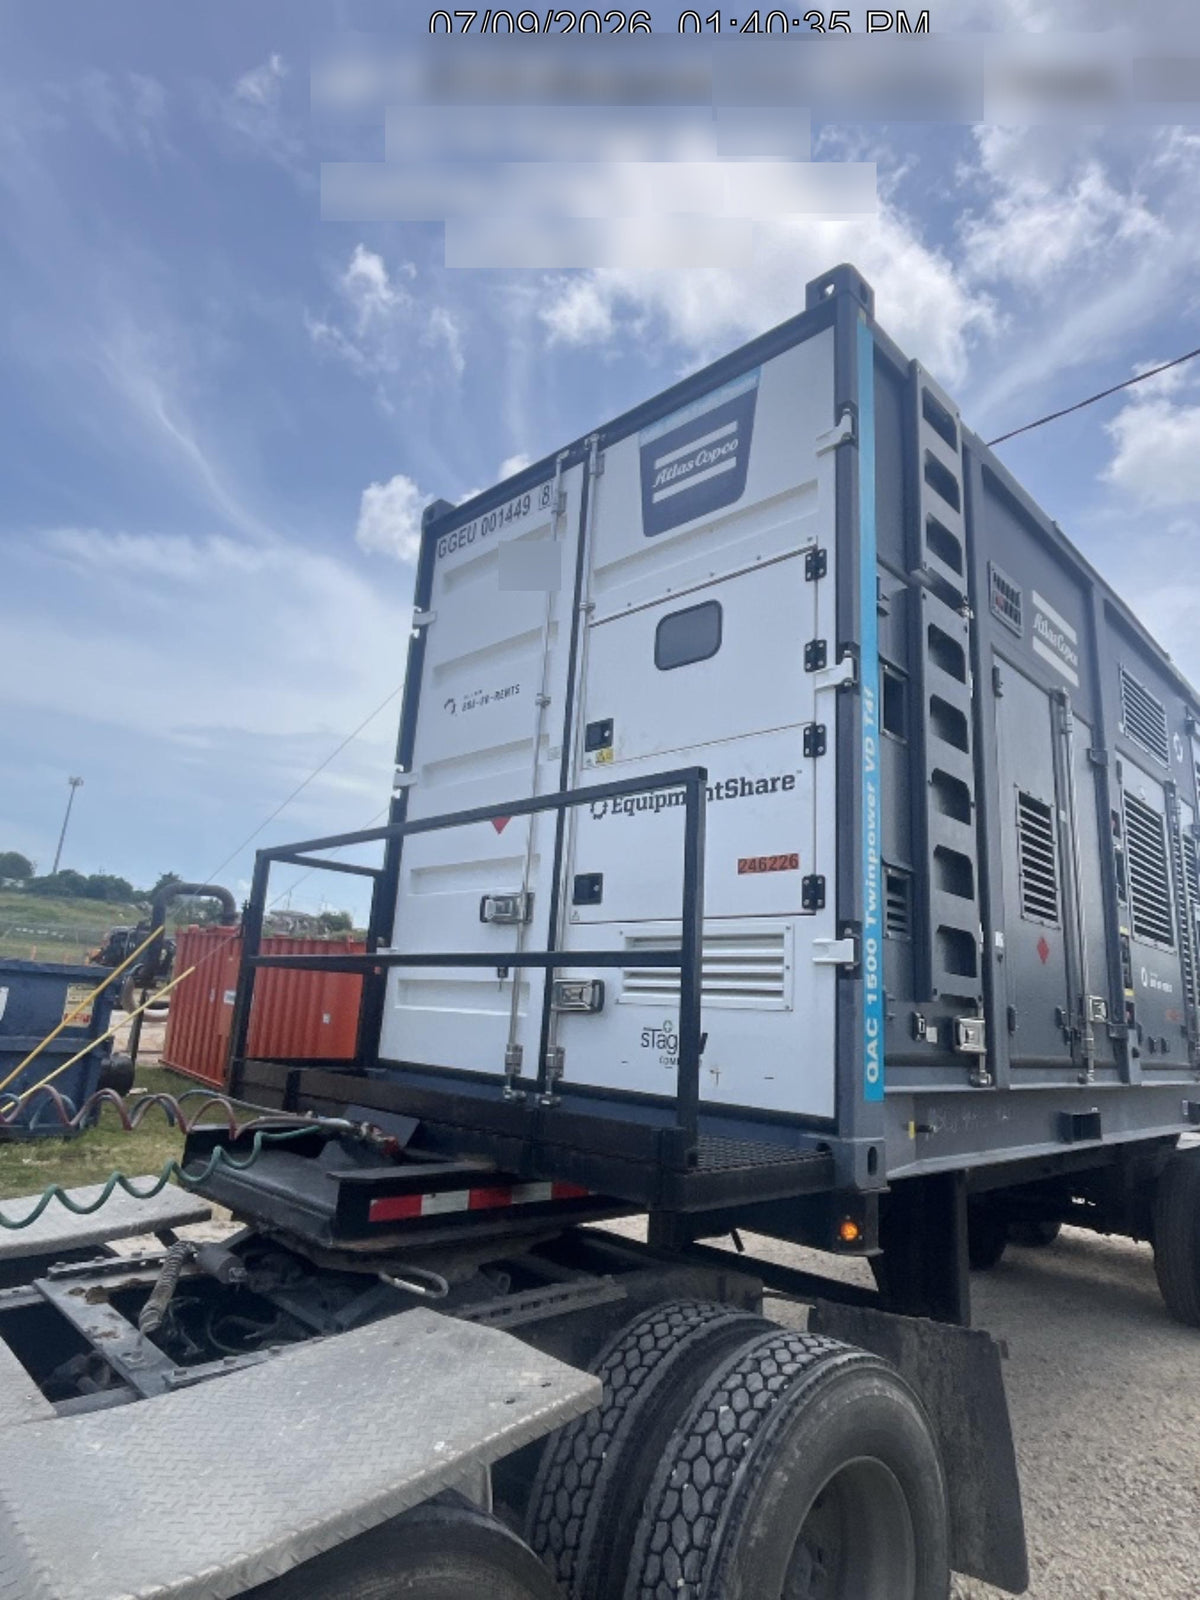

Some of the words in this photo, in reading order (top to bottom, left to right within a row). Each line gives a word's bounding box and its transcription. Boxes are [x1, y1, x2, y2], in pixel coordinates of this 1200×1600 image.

[652, 459, 694, 488] Atlas
[695, 438, 739, 467] Copco
[438, 522, 477, 559] GGEU
[481, 494, 531, 537] 001449
[865, 736, 876, 773] VD
[611, 774, 796, 816] EquipmntShare
[738, 855, 799, 873] 246226
[865, 780, 878, 928] Twinpower
[866, 938, 878, 1004] 1500
[866, 1018, 879, 1083] QAC
